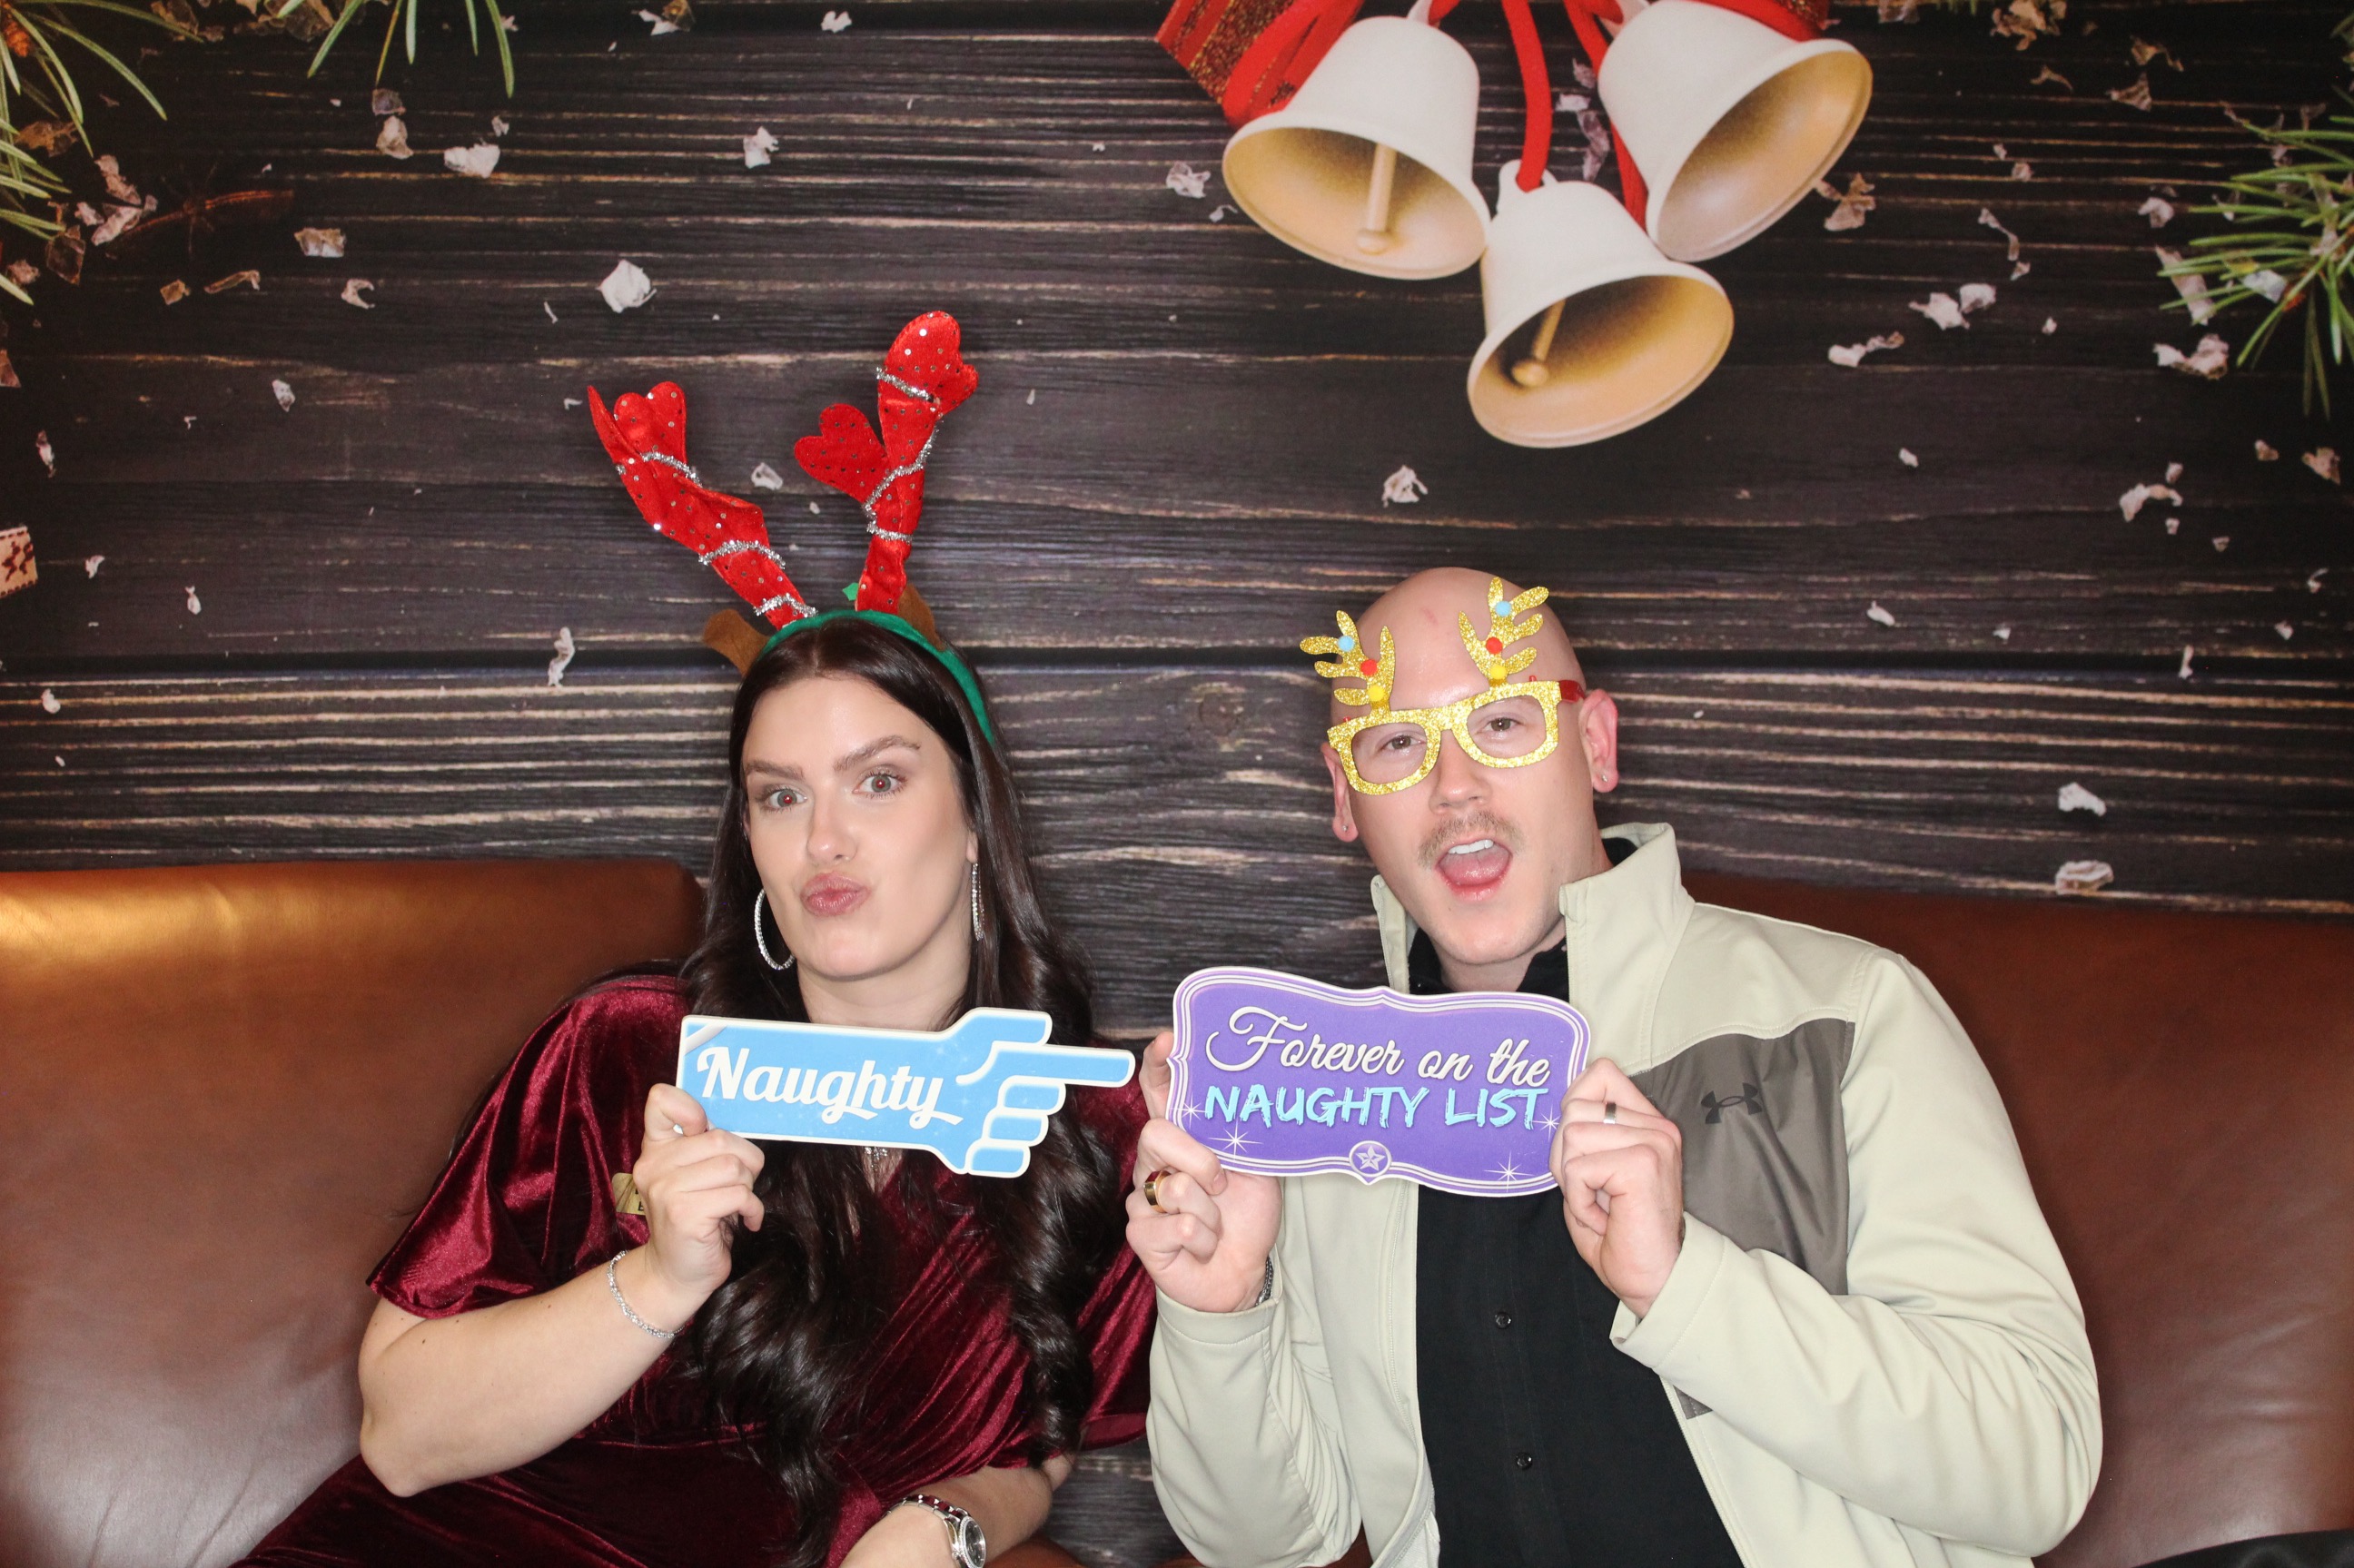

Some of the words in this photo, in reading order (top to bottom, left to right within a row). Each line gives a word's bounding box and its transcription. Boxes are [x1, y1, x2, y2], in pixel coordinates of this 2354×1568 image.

[1205, 1007, 1405, 1075] Forever
[1418, 1050, 1473, 1081] on
[1486, 1039, 1550, 1087] the
[697, 1046, 964, 1129] Naughty
[1205, 1084, 1428, 1129] NAUGHTY
[1445, 1088, 1549, 1130] LIST
